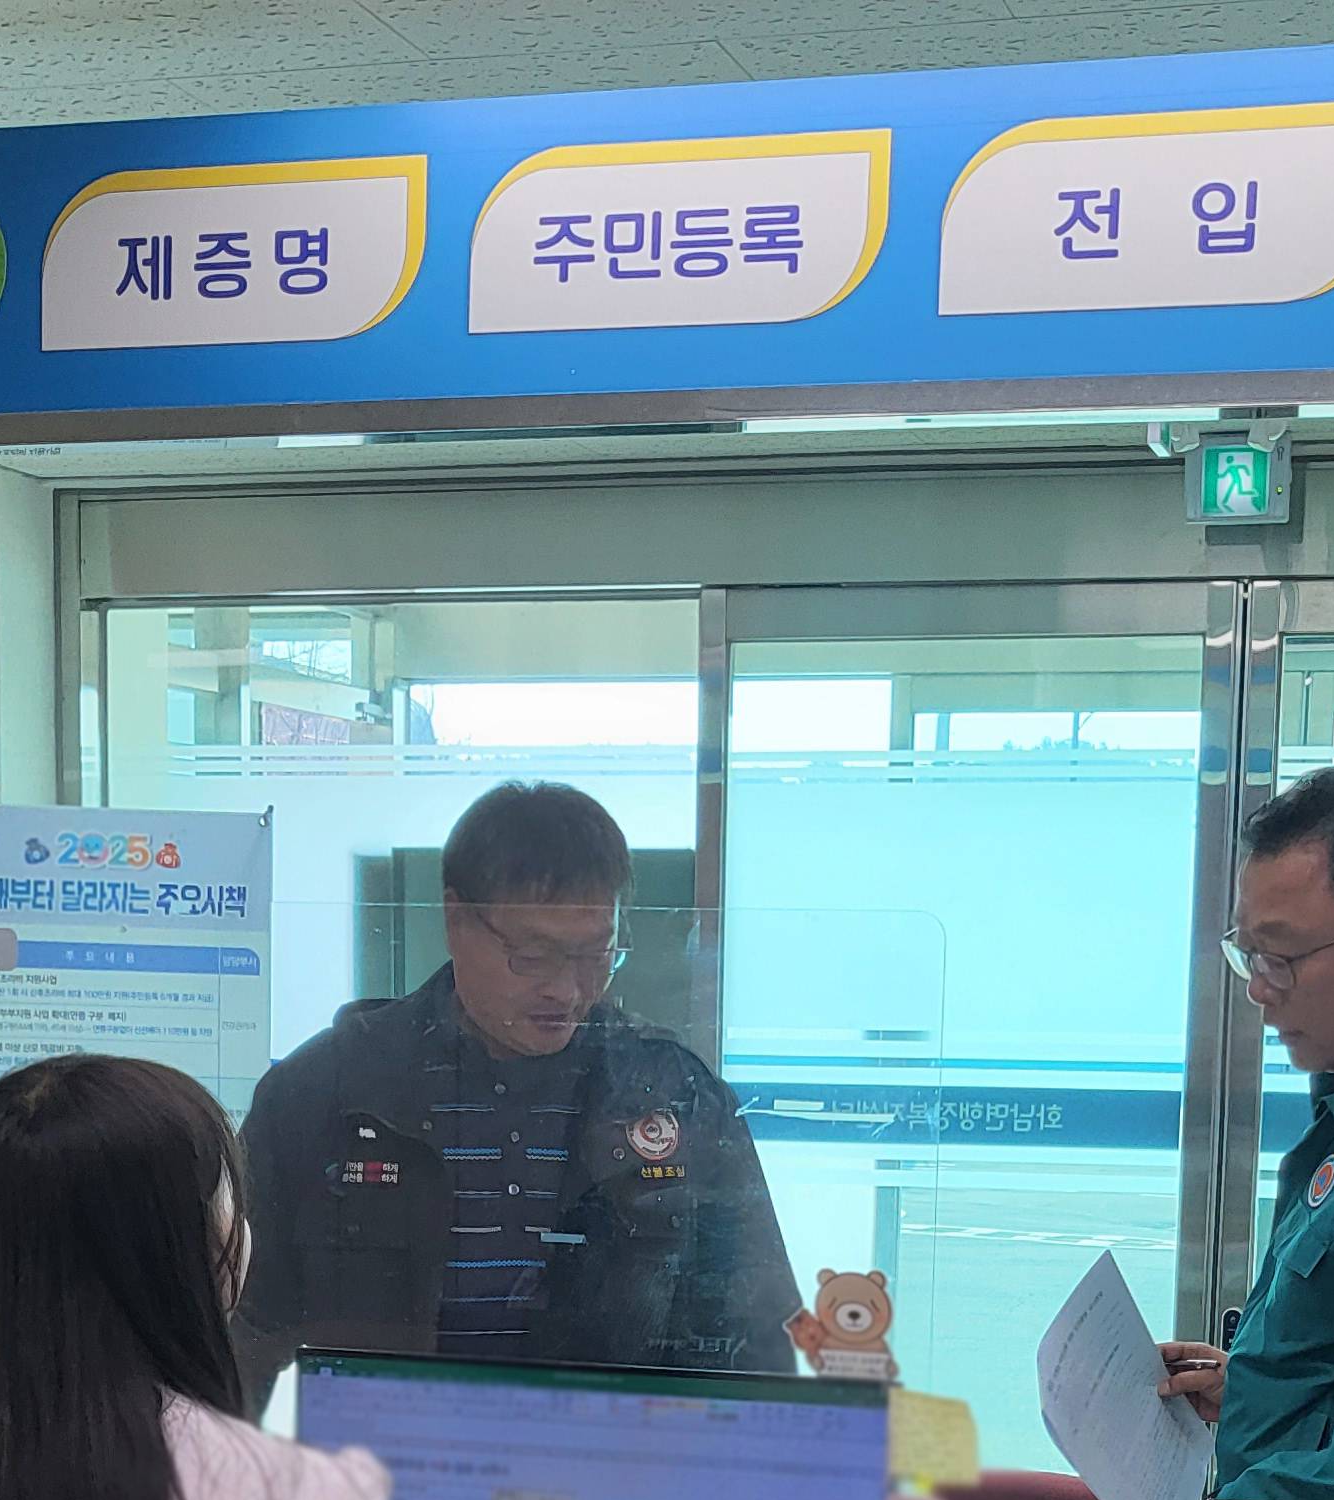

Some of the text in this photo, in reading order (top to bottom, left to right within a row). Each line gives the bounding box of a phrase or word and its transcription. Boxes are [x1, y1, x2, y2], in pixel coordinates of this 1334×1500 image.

[116, 226, 329, 300] 제증명
[533, 205, 804, 285] 주민등록
[61, 880, 150, 914] 달라지는
[156, 884, 247, 917] 주요시책
[26, 975, 57, 985] 지원사업
